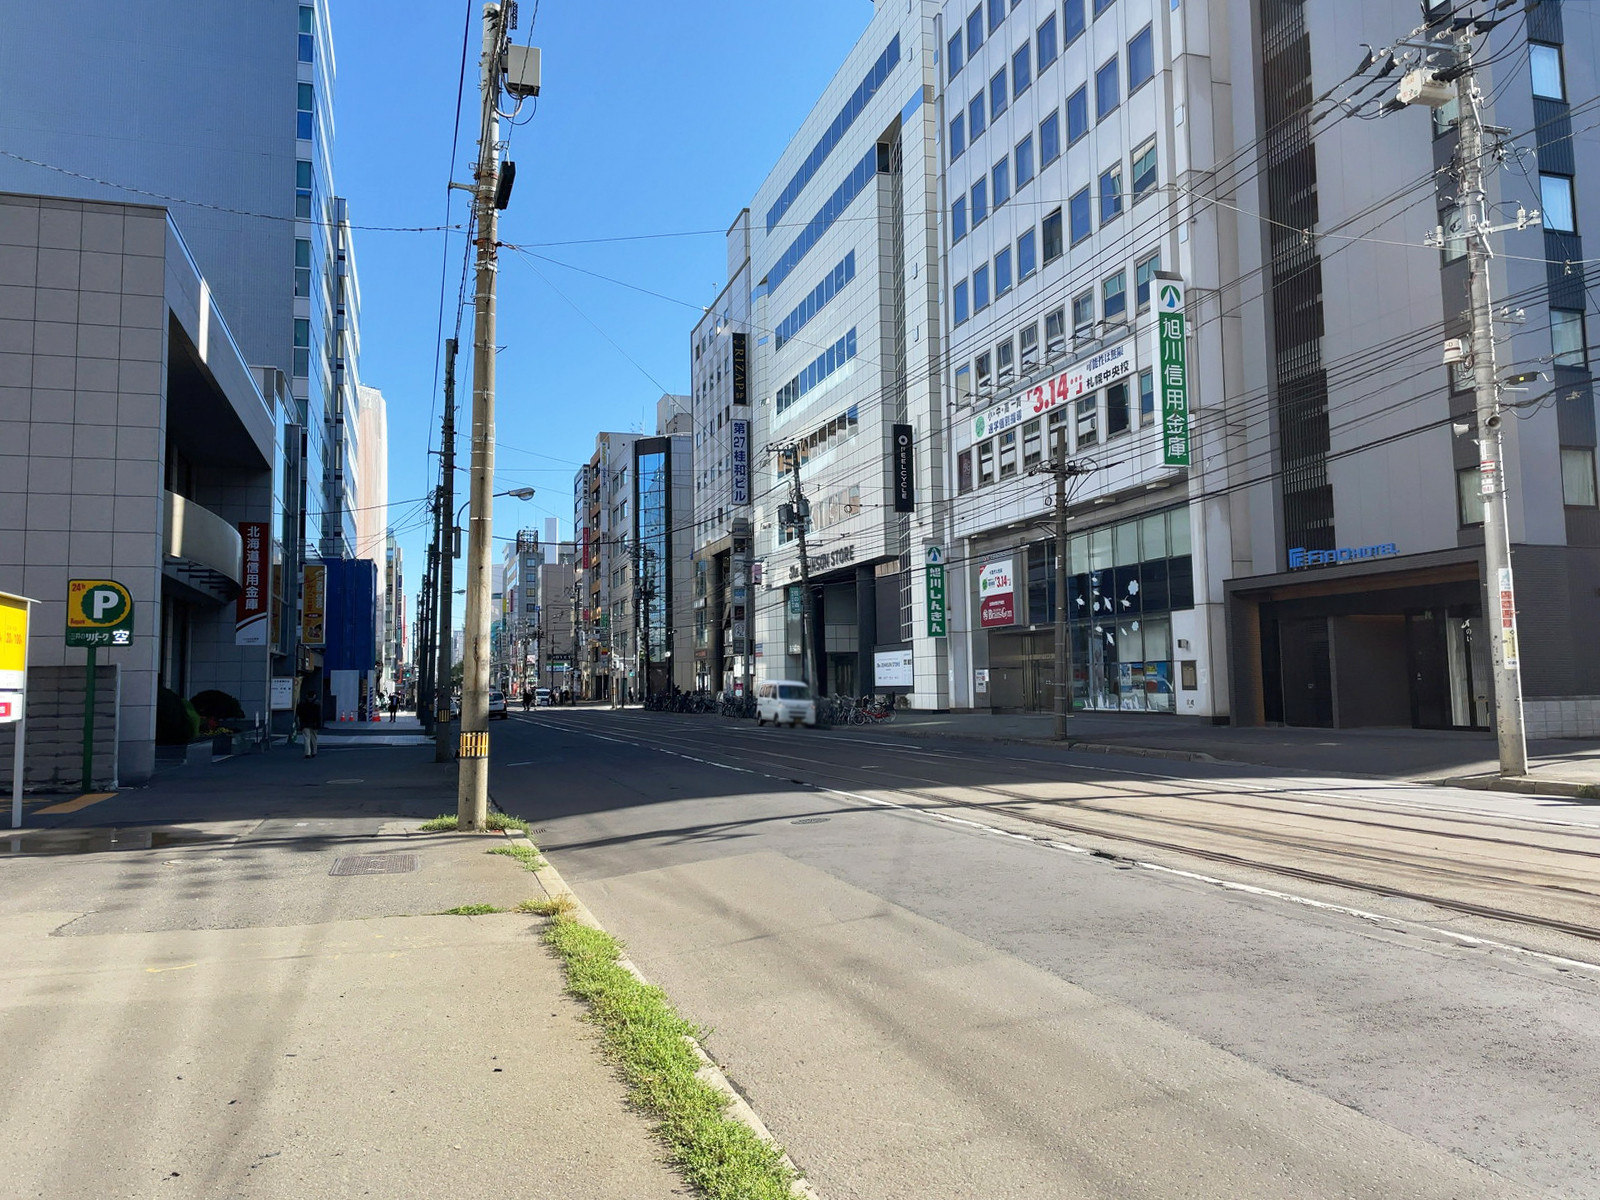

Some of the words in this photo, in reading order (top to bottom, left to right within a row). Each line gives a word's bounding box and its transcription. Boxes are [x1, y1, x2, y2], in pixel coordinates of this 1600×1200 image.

[734, 348, 745, 390] RIZAP
[1086, 360, 1130, 390] 札幌中央校
[1163, 317, 1187, 459] 旭川信用金庫
[733, 422, 747, 502] 第27桂和ビル
[244, 525, 261, 611] 北海道信用金庫
[831, 544, 855, 567] STORE
[1353, 543, 1400, 559] HOTEL
[93, 590, 119, 619] P
[929, 567, 943, 633] 旭川しんきん
[112, 629, 130, 645] 空
